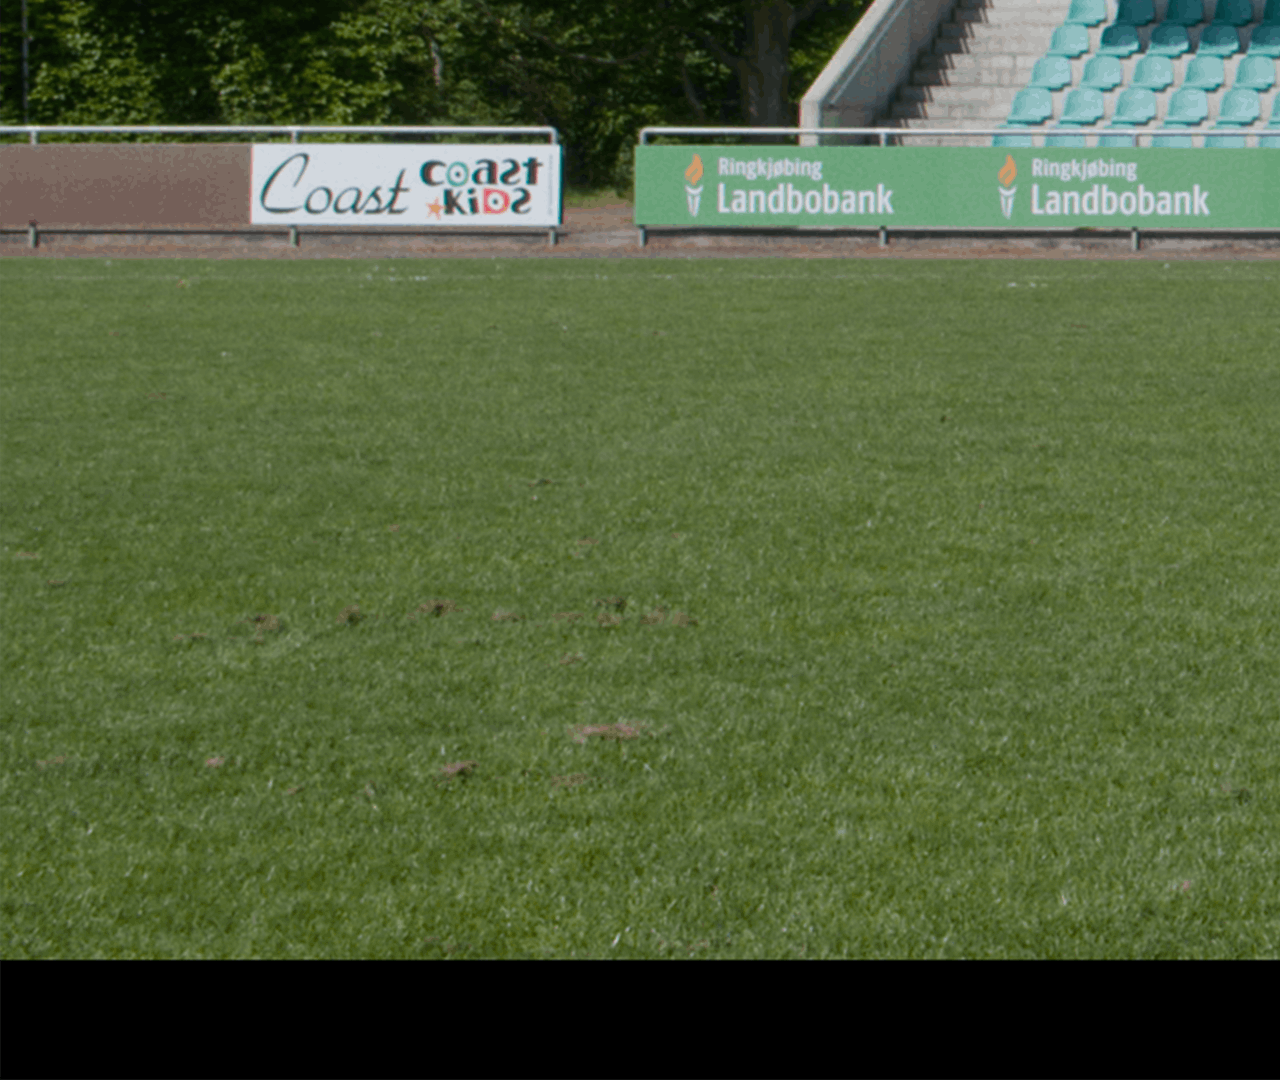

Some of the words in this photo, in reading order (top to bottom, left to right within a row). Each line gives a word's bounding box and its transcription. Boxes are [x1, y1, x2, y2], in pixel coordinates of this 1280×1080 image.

[260, 153, 410, 216] Coast
[717, 156, 823, 181] Ringkjøbing
[1031, 158, 1137, 182] Ringkjøbing
[717, 183, 894, 215] Landbobank
[1031, 184, 1210, 216] Landbobank
